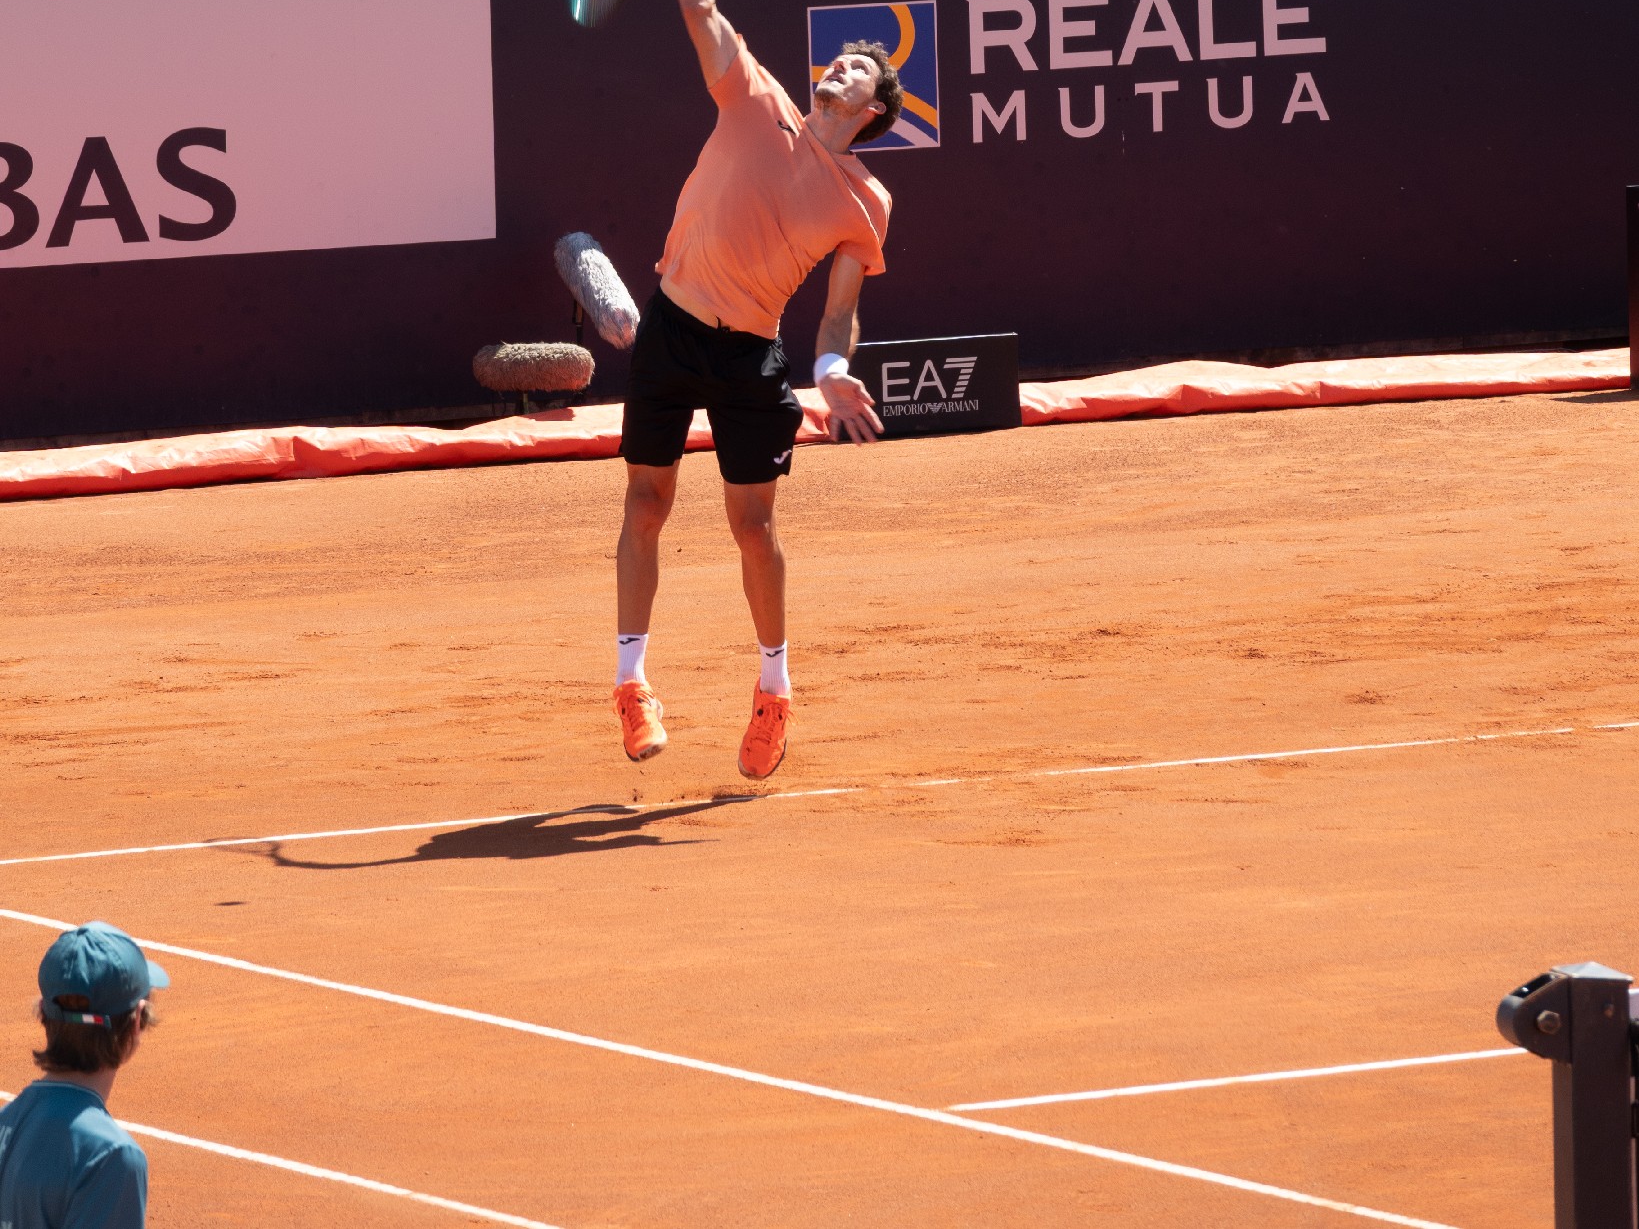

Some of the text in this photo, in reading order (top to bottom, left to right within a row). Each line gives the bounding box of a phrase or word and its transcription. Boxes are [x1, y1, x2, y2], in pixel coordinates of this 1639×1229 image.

[970, 71, 1331, 144] MUTUA
[881, 356, 978, 403] EA7
[883, 399, 979, 417] EMPORIO ARMANI
